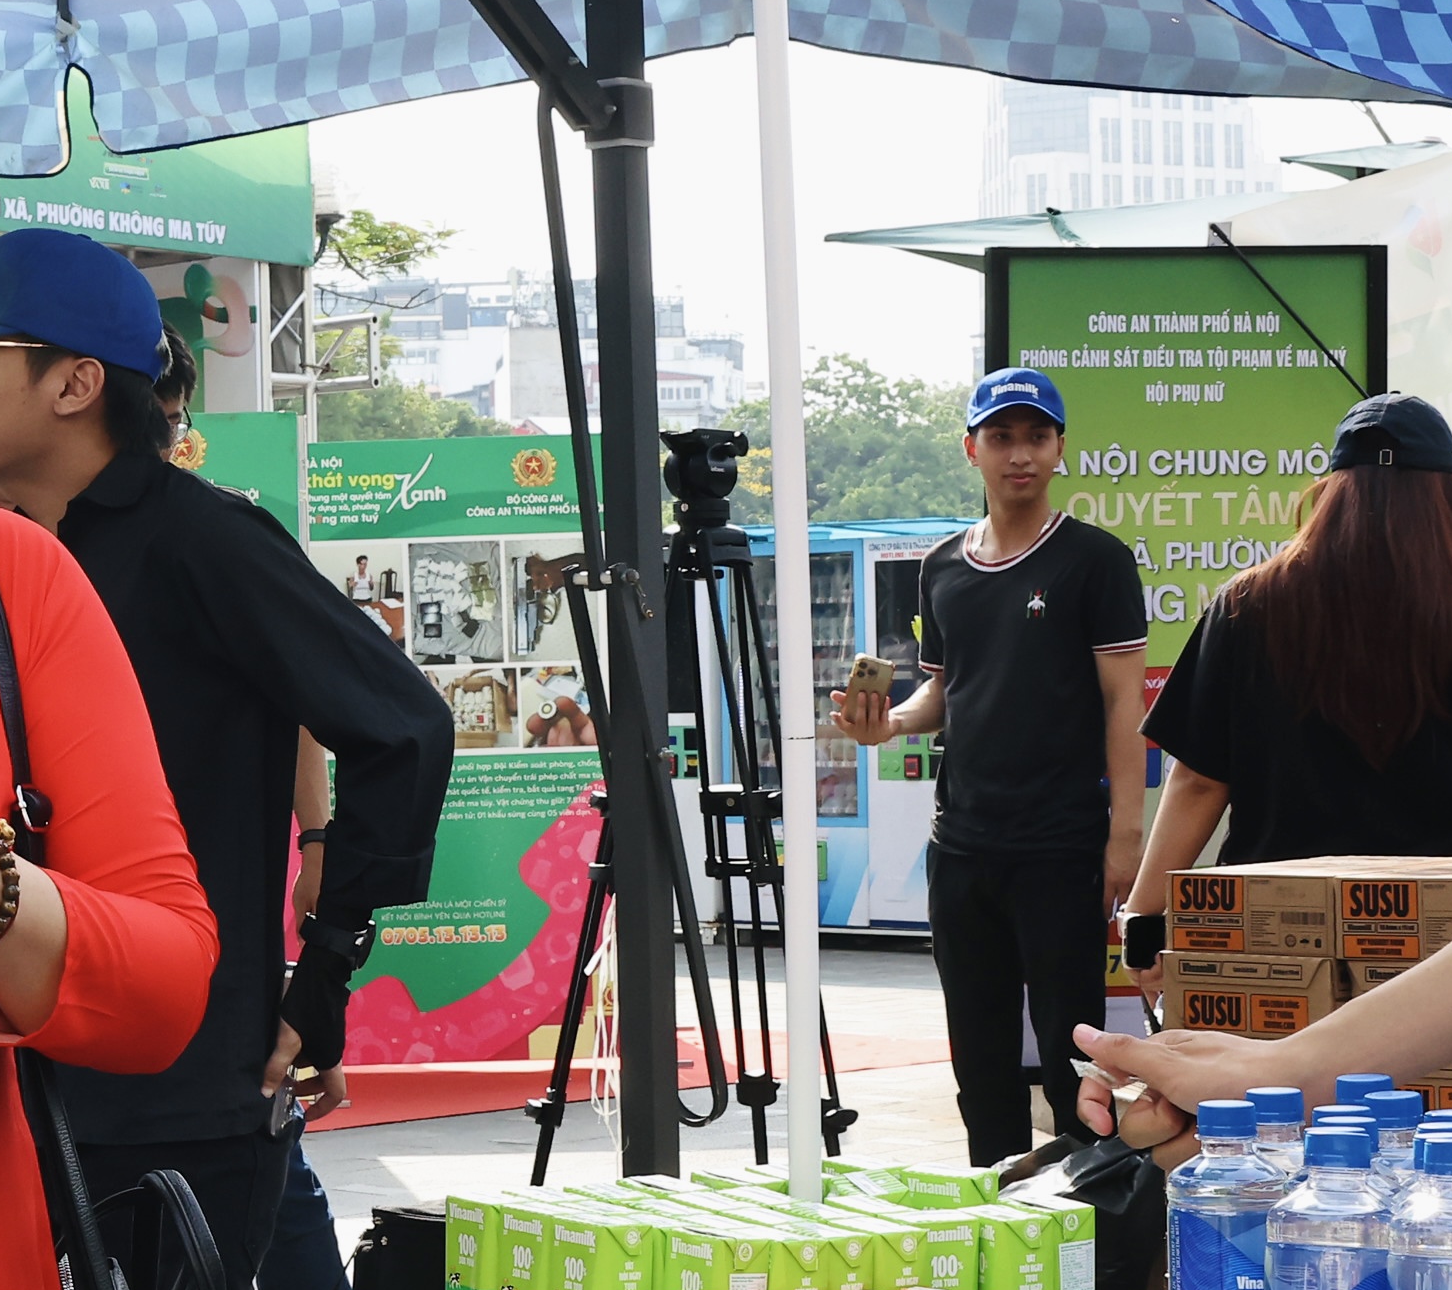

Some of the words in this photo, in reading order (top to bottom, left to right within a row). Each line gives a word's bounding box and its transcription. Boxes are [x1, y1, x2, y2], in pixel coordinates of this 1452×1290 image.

[4, 197, 33, 223] XÃ,
[36, 201, 105, 231] PHƯỜNG
[108, 210, 164, 239] KHÔNG
[168, 219, 193, 241] MA
[1088, 310, 1127, 334] CÔNG
[1130, 314, 1150, 333] AN
[1153, 310, 1199, 334] THÀNH
[1202, 308, 1231, 333] PHỐ
[1234, 310, 1252, 334] HÀ
[1255, 310, 1281, 337] NỘI
[1019, 345, 1068, 369] PHÒNG
[1071, 343, 1110, 369] CẢNH
[1113, 345, 1140, 369] SÁT
[1142, 342, 1175, 369] ĐIỀU
[1177, 349, 1203, 368] TRA
[1207, 345, 1228, 373] TỘI
[1231, 349, 1273, 373] PHẠM
[1275, 342, 1294, 369] VỀ
[1296, 349, 1319, 368] MA
[991, 382, 1039, 397] Vinamilk
[1145, 380, 1169, 407] HỘI
[1172, 383, 1201, 407] PHỤ
[1204, 380, 1225, 403] NỮ
[321, 455, 343, 472] NỘI
[1079, 442, 1138, 484] NỘI
[1148, 449, 1268, 476] CHUNG
[1277, 441, 1333, 483] MỘ
[348, 473, 396, 493] vọng
[520, 493, 548, 505] CÔNG
[549, 493, 564, 503] AN
[1066, 479, 1202, 528] QUYẾT
[1212, 483, 1300, 526] TÂM
[339, 515, 359, 524] ma
[466, 506, 496, 518] CÔNG
[497, 507, 512, 517] AN
[512, 505, 547, 517] THÀNH
[1180, 877, 1236, 911] SUSU
[1349, 883, 1410, 917] SUSU
[473, 910, 506, 919] HOTLINE
[380, 923, 507, 946] 0705.13.13.13
[1189, 994, 1241, 1027] SUSU
[907, 1177, 961, 1198] Vinamilk
[449, 1202, 485, 1225] Vinamilk
[503, 1213, 543, 1237] Vinamilk
[554, 1224, 596, 1248] Vinamilk
[671, 1236, 713, 1261] Vinamilk
